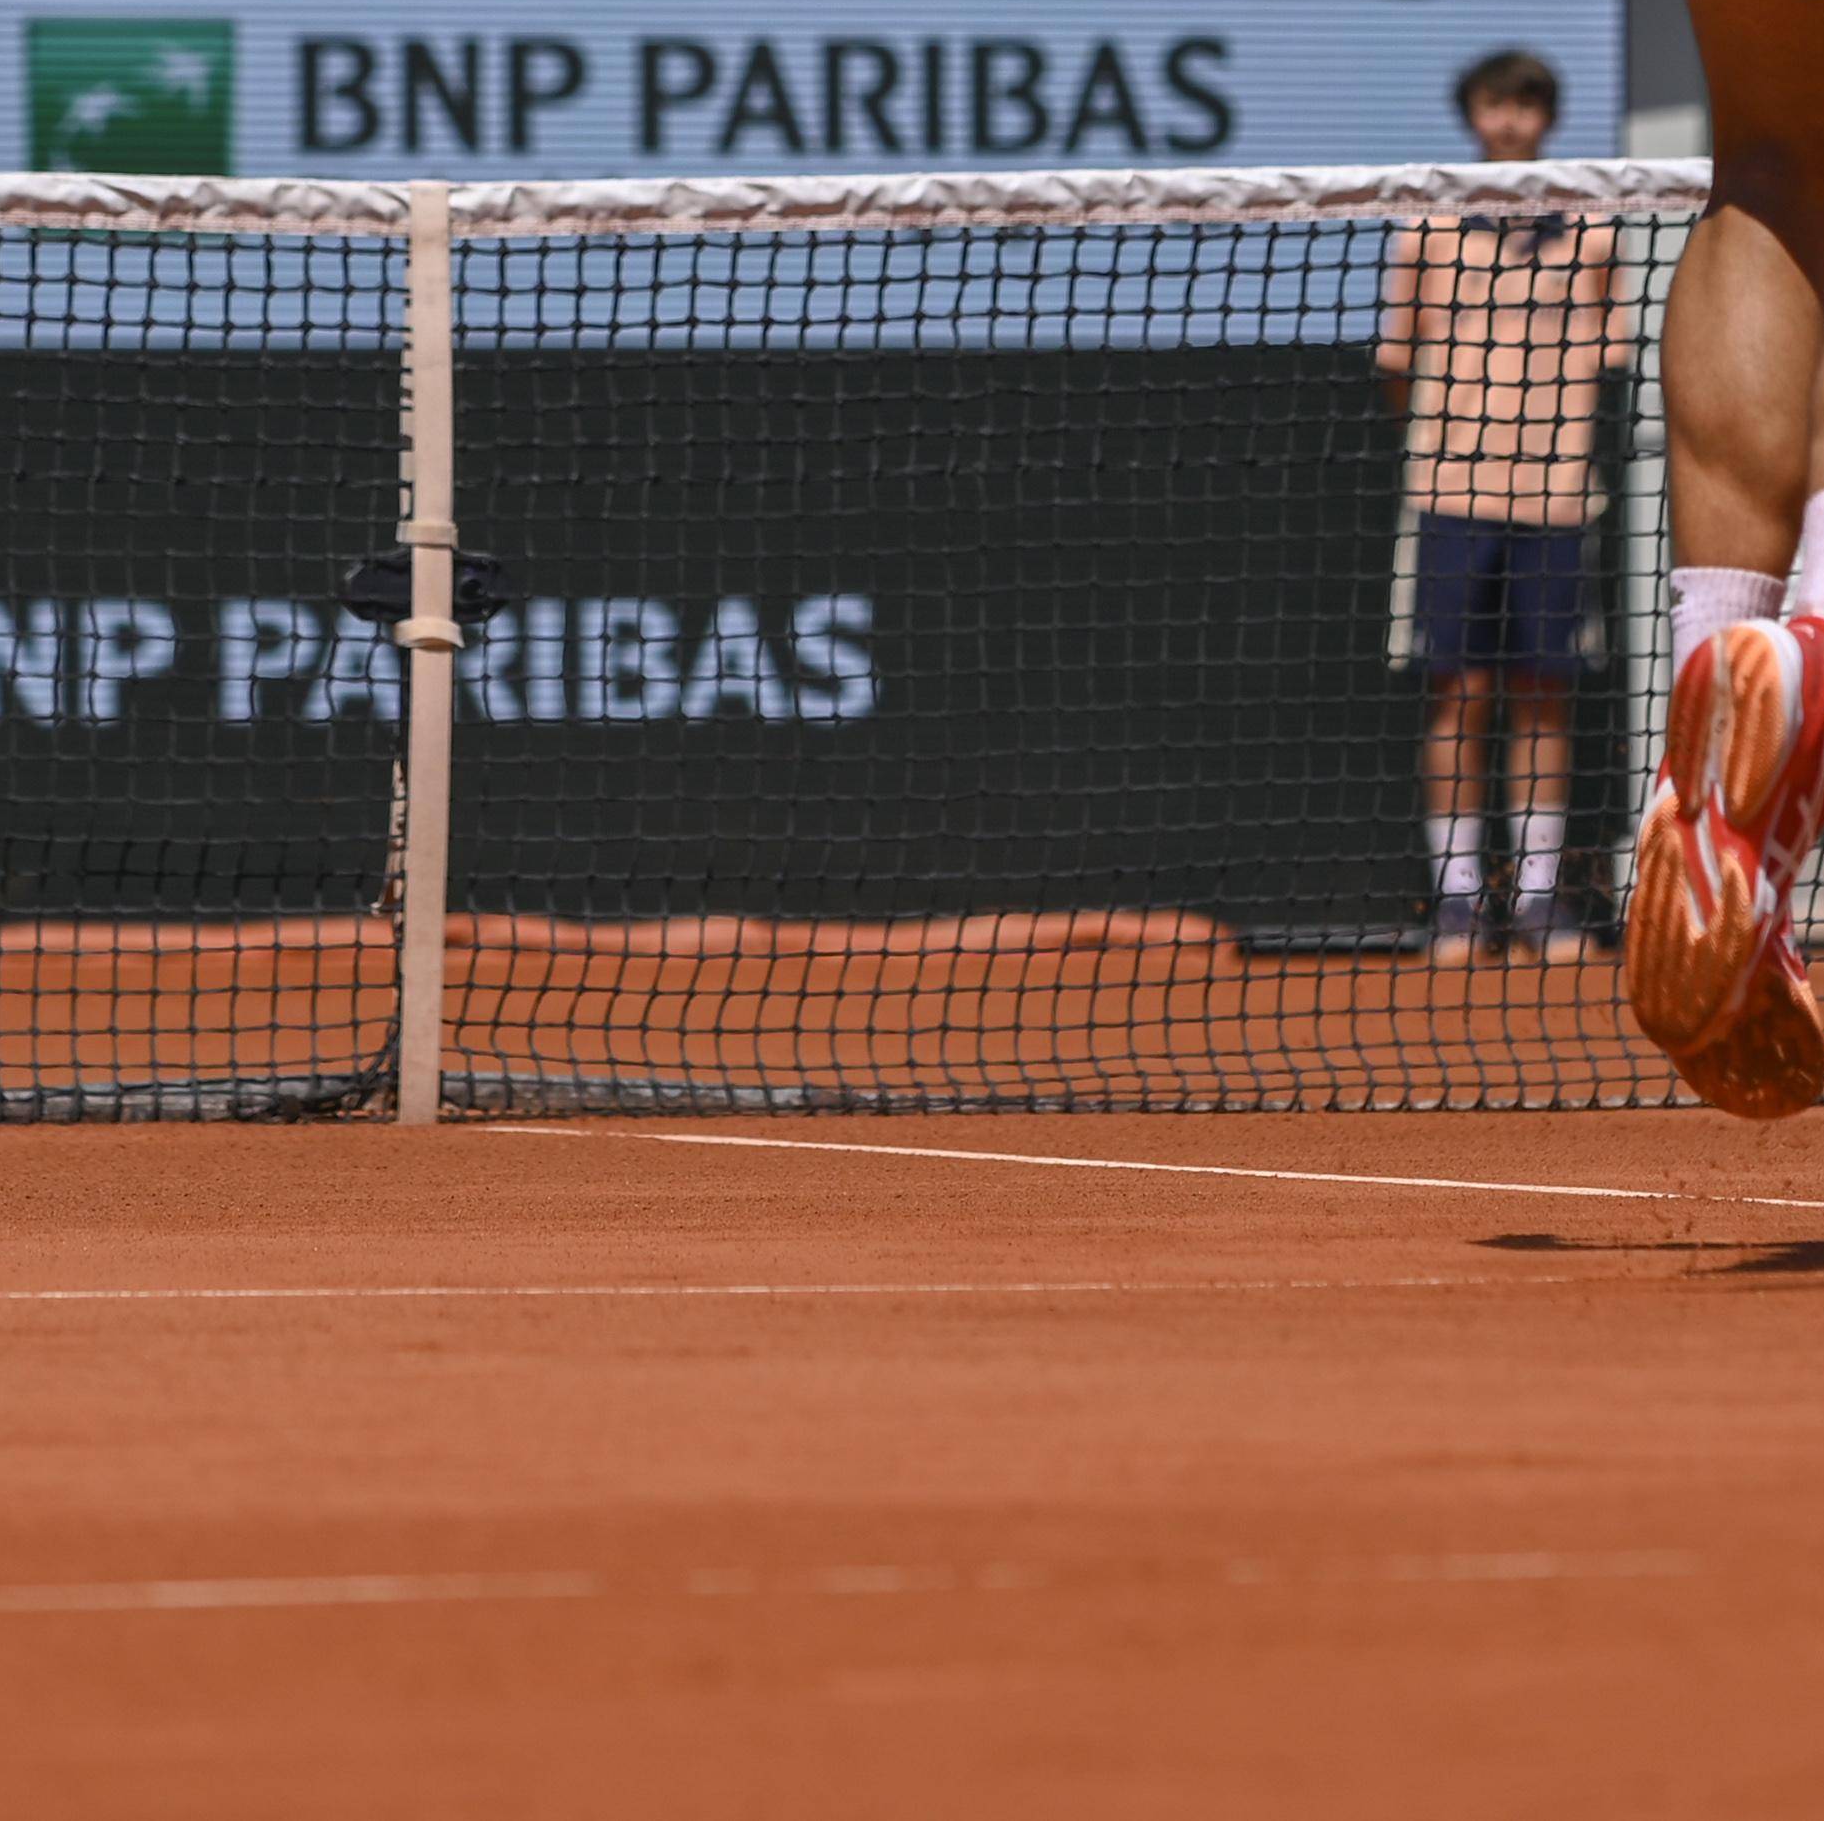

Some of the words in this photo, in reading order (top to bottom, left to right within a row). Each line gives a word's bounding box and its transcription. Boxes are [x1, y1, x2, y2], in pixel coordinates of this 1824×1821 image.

[297, 34, 587, 155] BNP
[637, 34, 1239, 156] PARIBAS
[213, 591, 879, 728] PARIBAS
